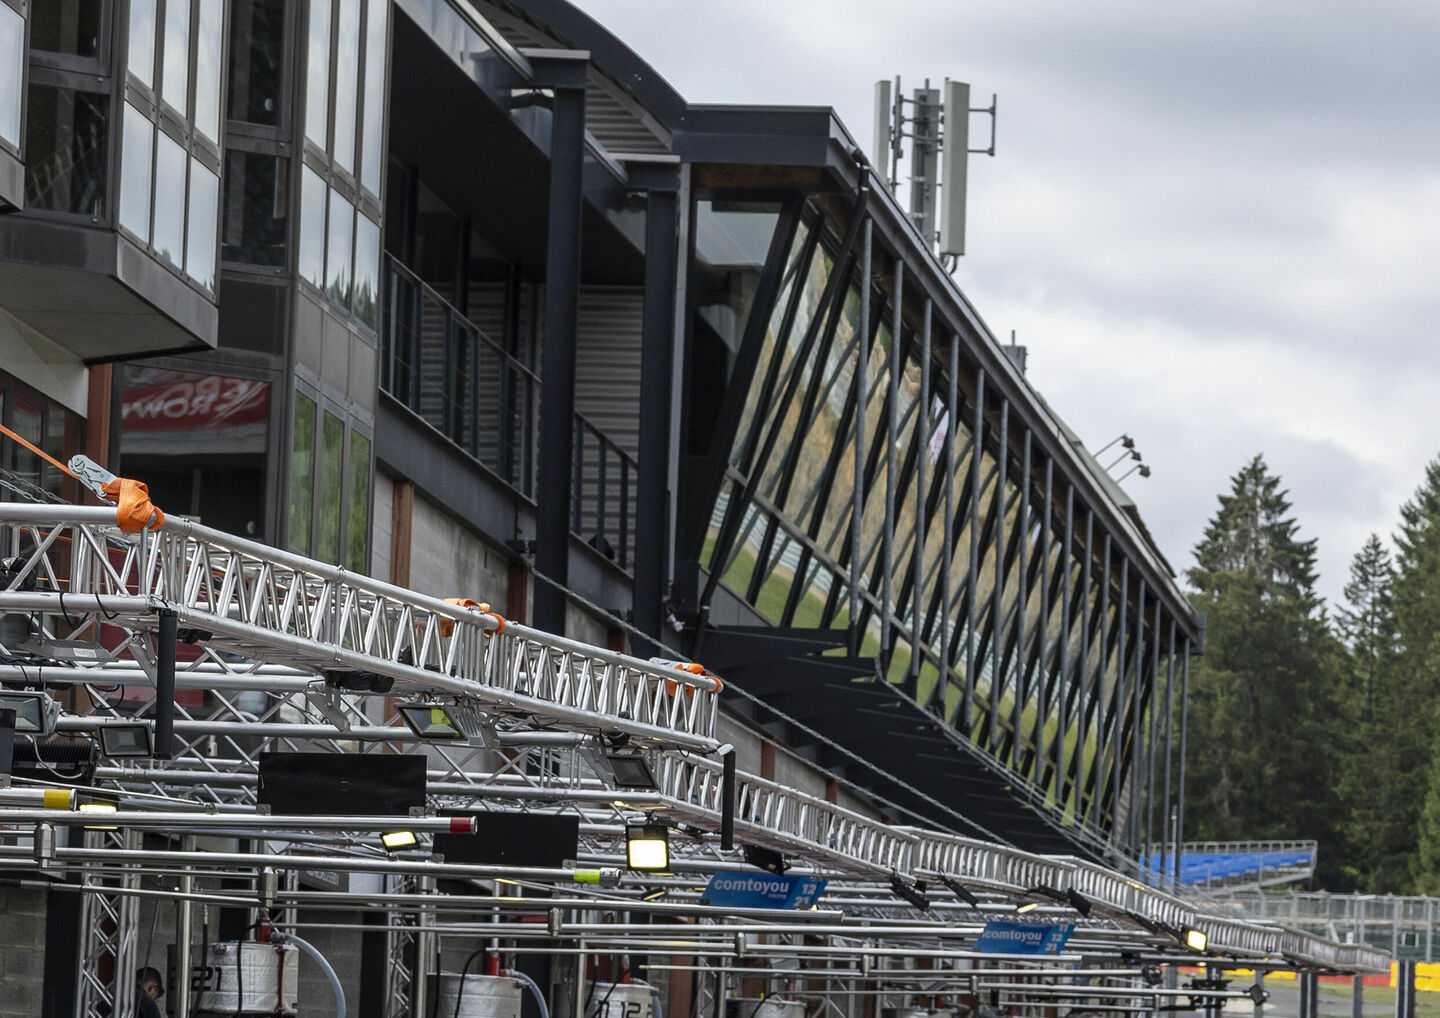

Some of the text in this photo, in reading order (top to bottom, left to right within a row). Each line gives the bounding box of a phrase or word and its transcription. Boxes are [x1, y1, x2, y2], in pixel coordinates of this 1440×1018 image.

[714, 879, 789, 895] comtoyou
[802, 884, 817, 894] 12
[985, 930, 1042, 944] comtoyou
